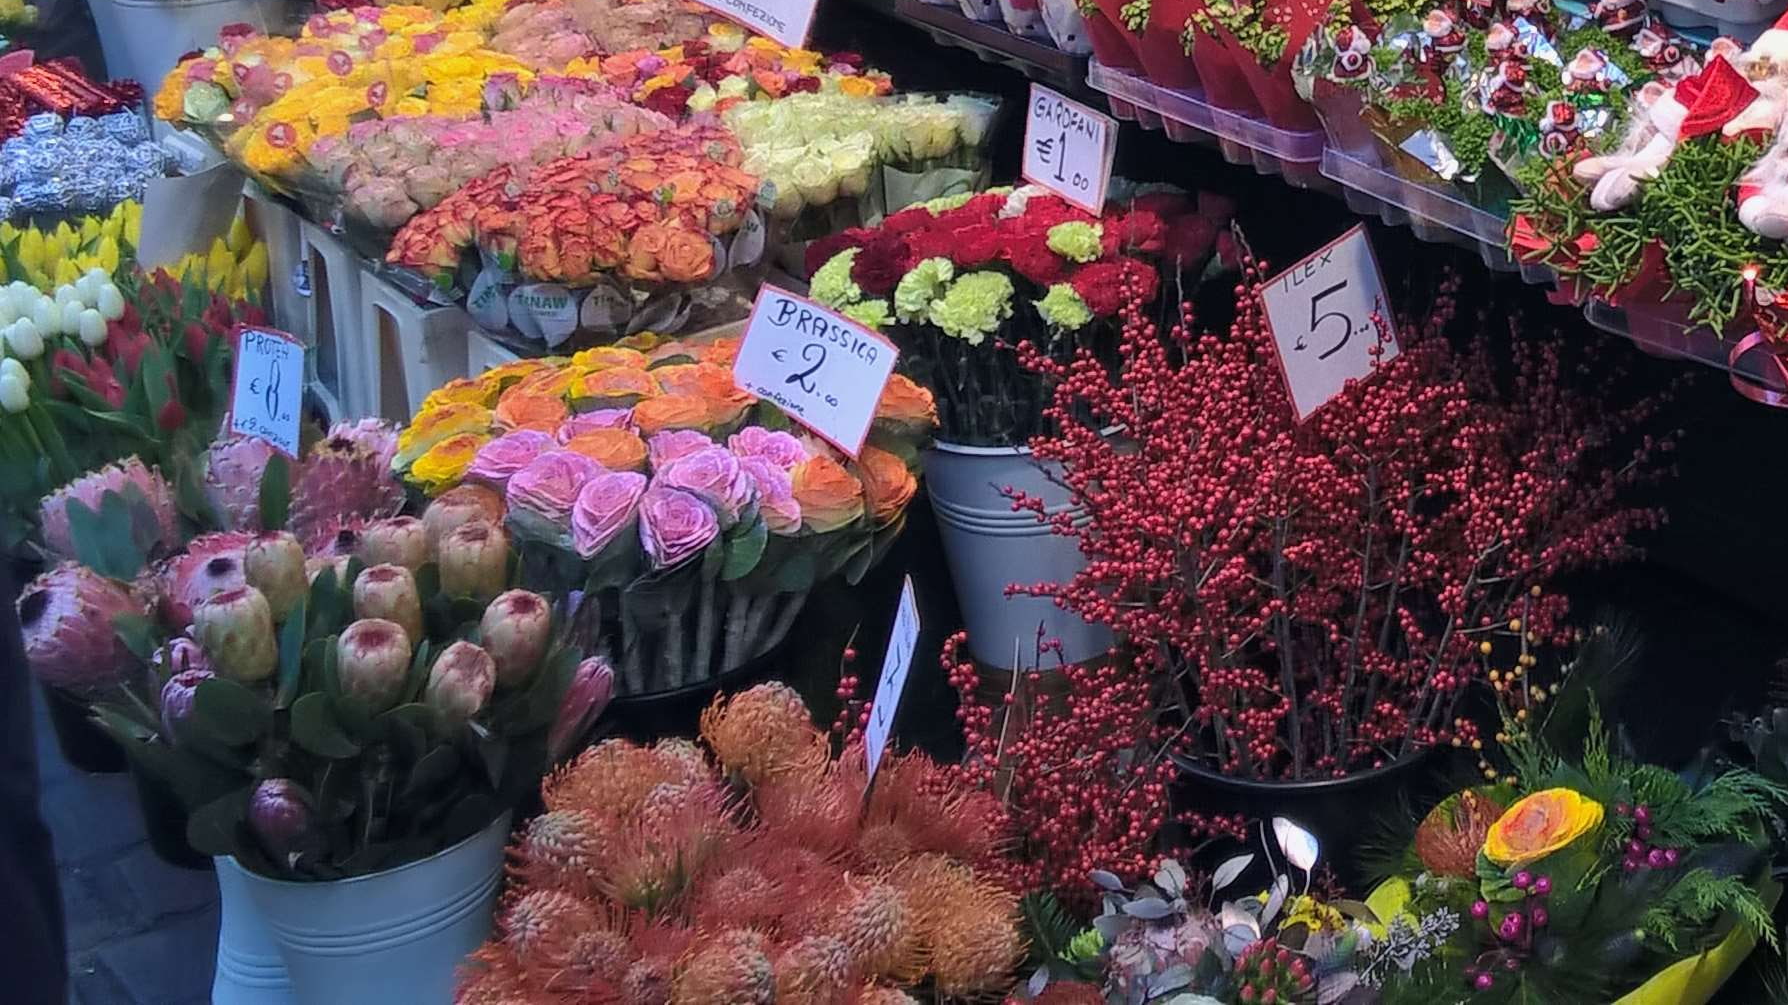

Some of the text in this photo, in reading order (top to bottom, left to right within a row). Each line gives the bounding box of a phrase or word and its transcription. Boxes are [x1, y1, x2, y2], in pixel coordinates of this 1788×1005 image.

[1034, 96, 1100, 143] GAROFANI
[1282, 248, 1333, 293] ILEX
[767, 299, 878, 366] BRASSICA
